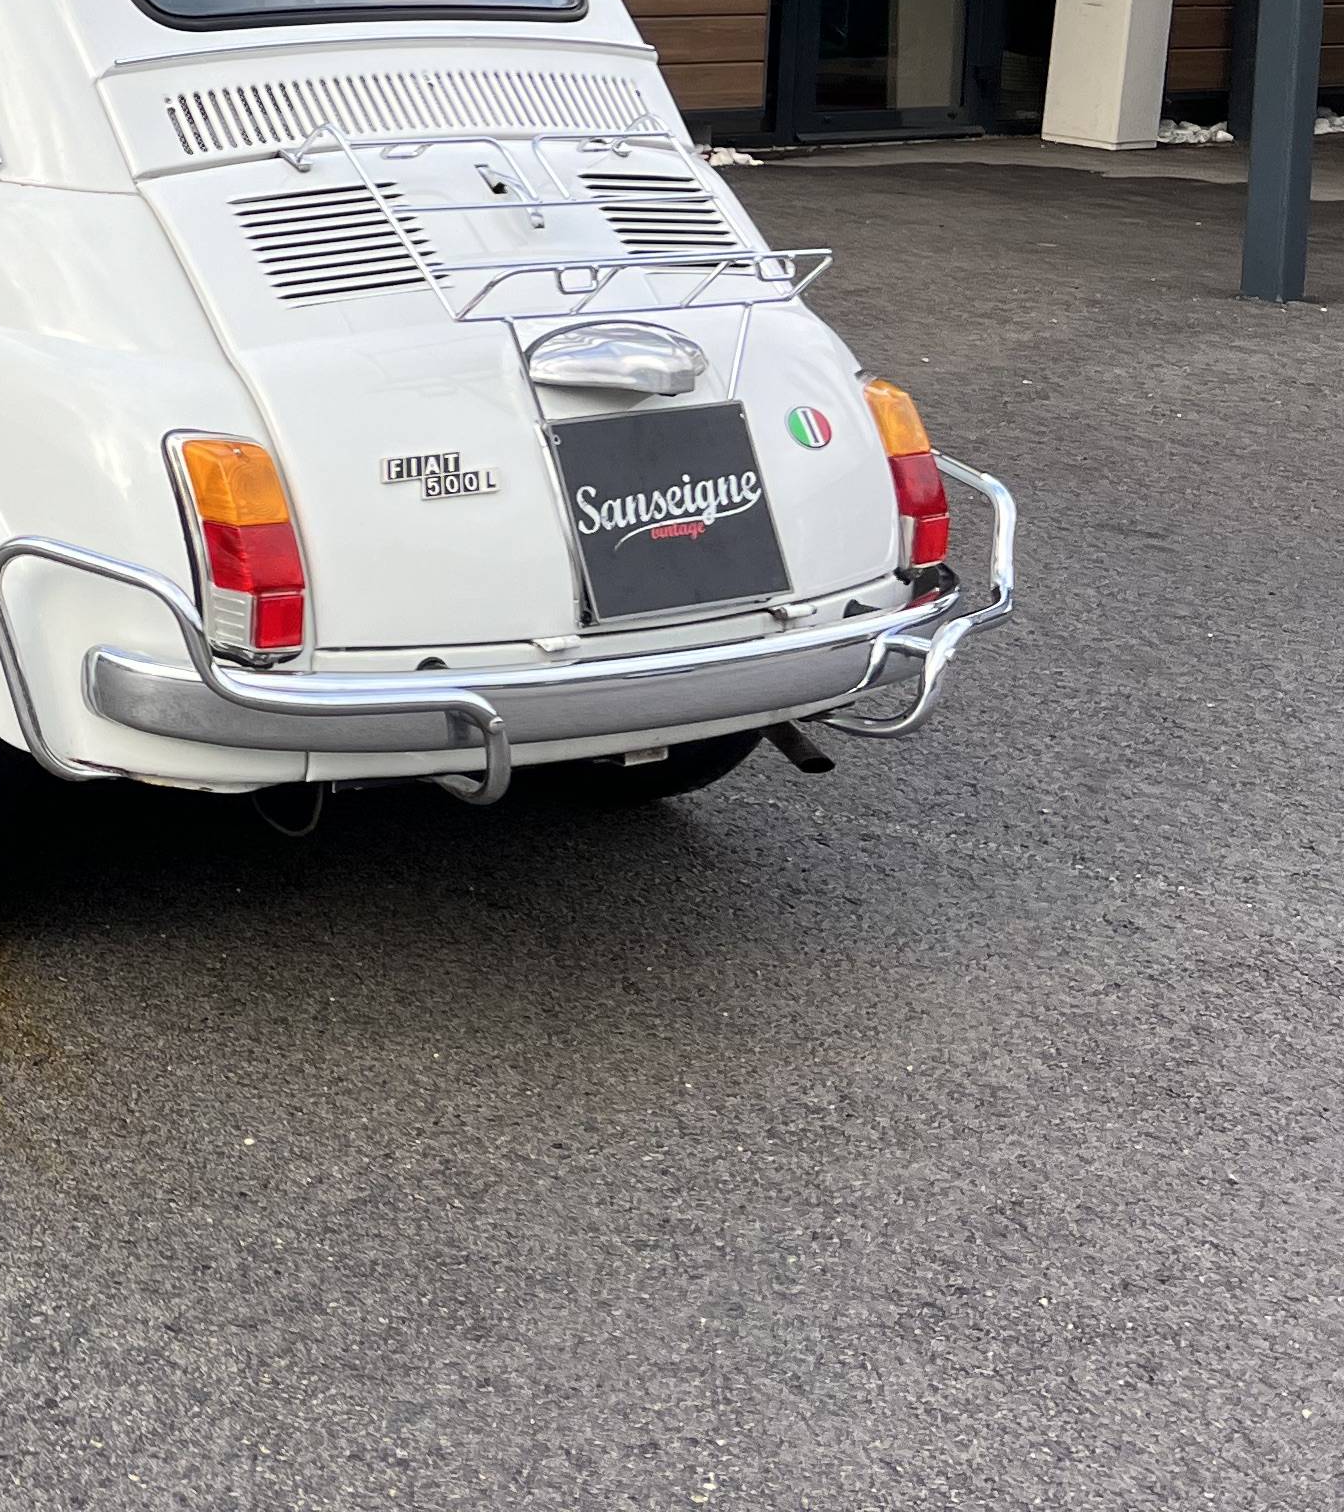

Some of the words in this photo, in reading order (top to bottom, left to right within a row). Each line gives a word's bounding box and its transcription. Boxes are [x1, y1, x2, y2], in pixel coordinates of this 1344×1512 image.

[389, 452, 459, 480] FIAT
[575, 471, 762, 537] Sanseigne
[649, 520, 706, 541] vintage
